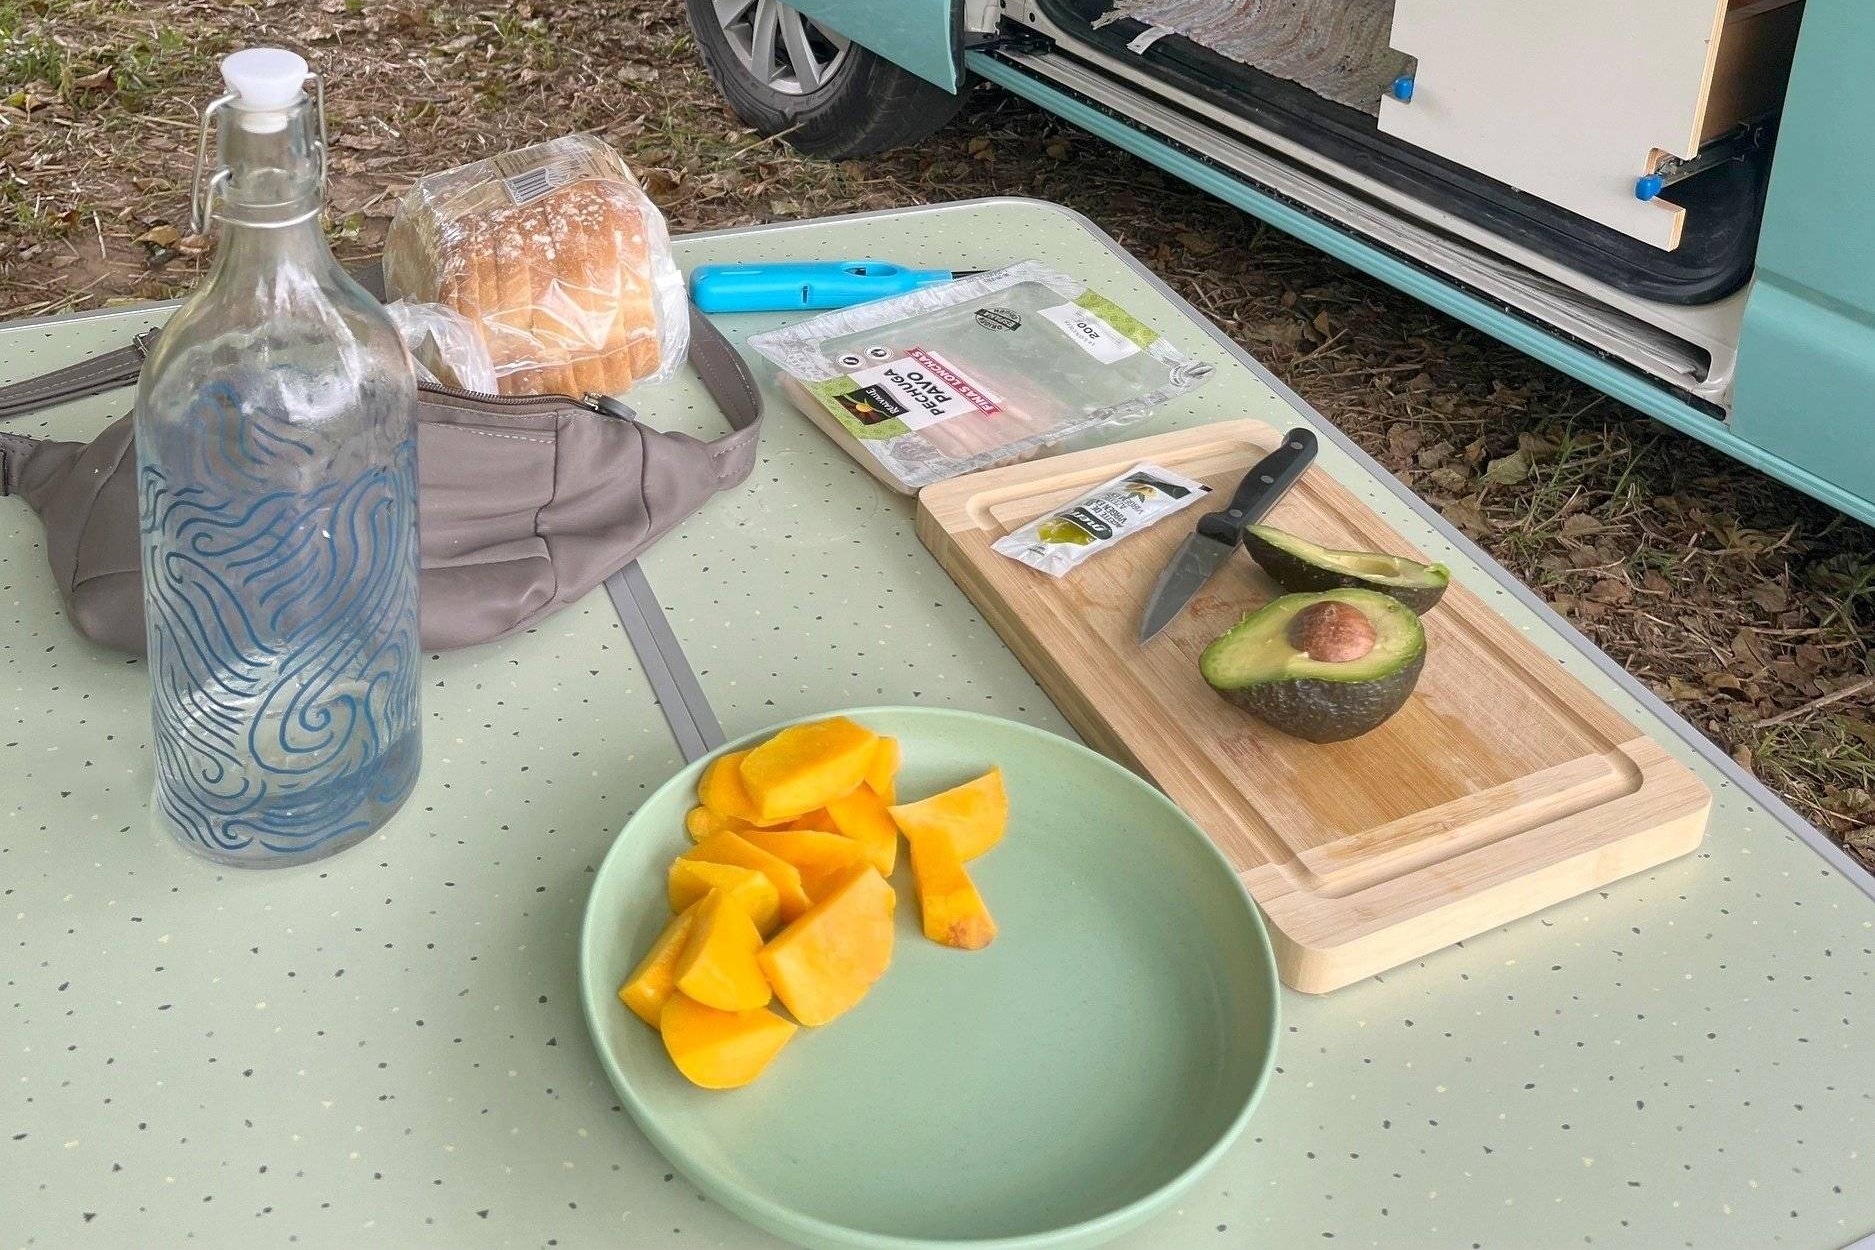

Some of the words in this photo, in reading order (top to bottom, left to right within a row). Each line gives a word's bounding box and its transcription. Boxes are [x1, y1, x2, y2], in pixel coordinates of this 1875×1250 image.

[1077, 322, 1101, 339] 200
[909, 350, 962, 386] LONCHAS
[880, 368, 946, 416] PECHUGA
[905, 371, 952, 403] PAVO
[956, 384, 995, 411] FINAS
